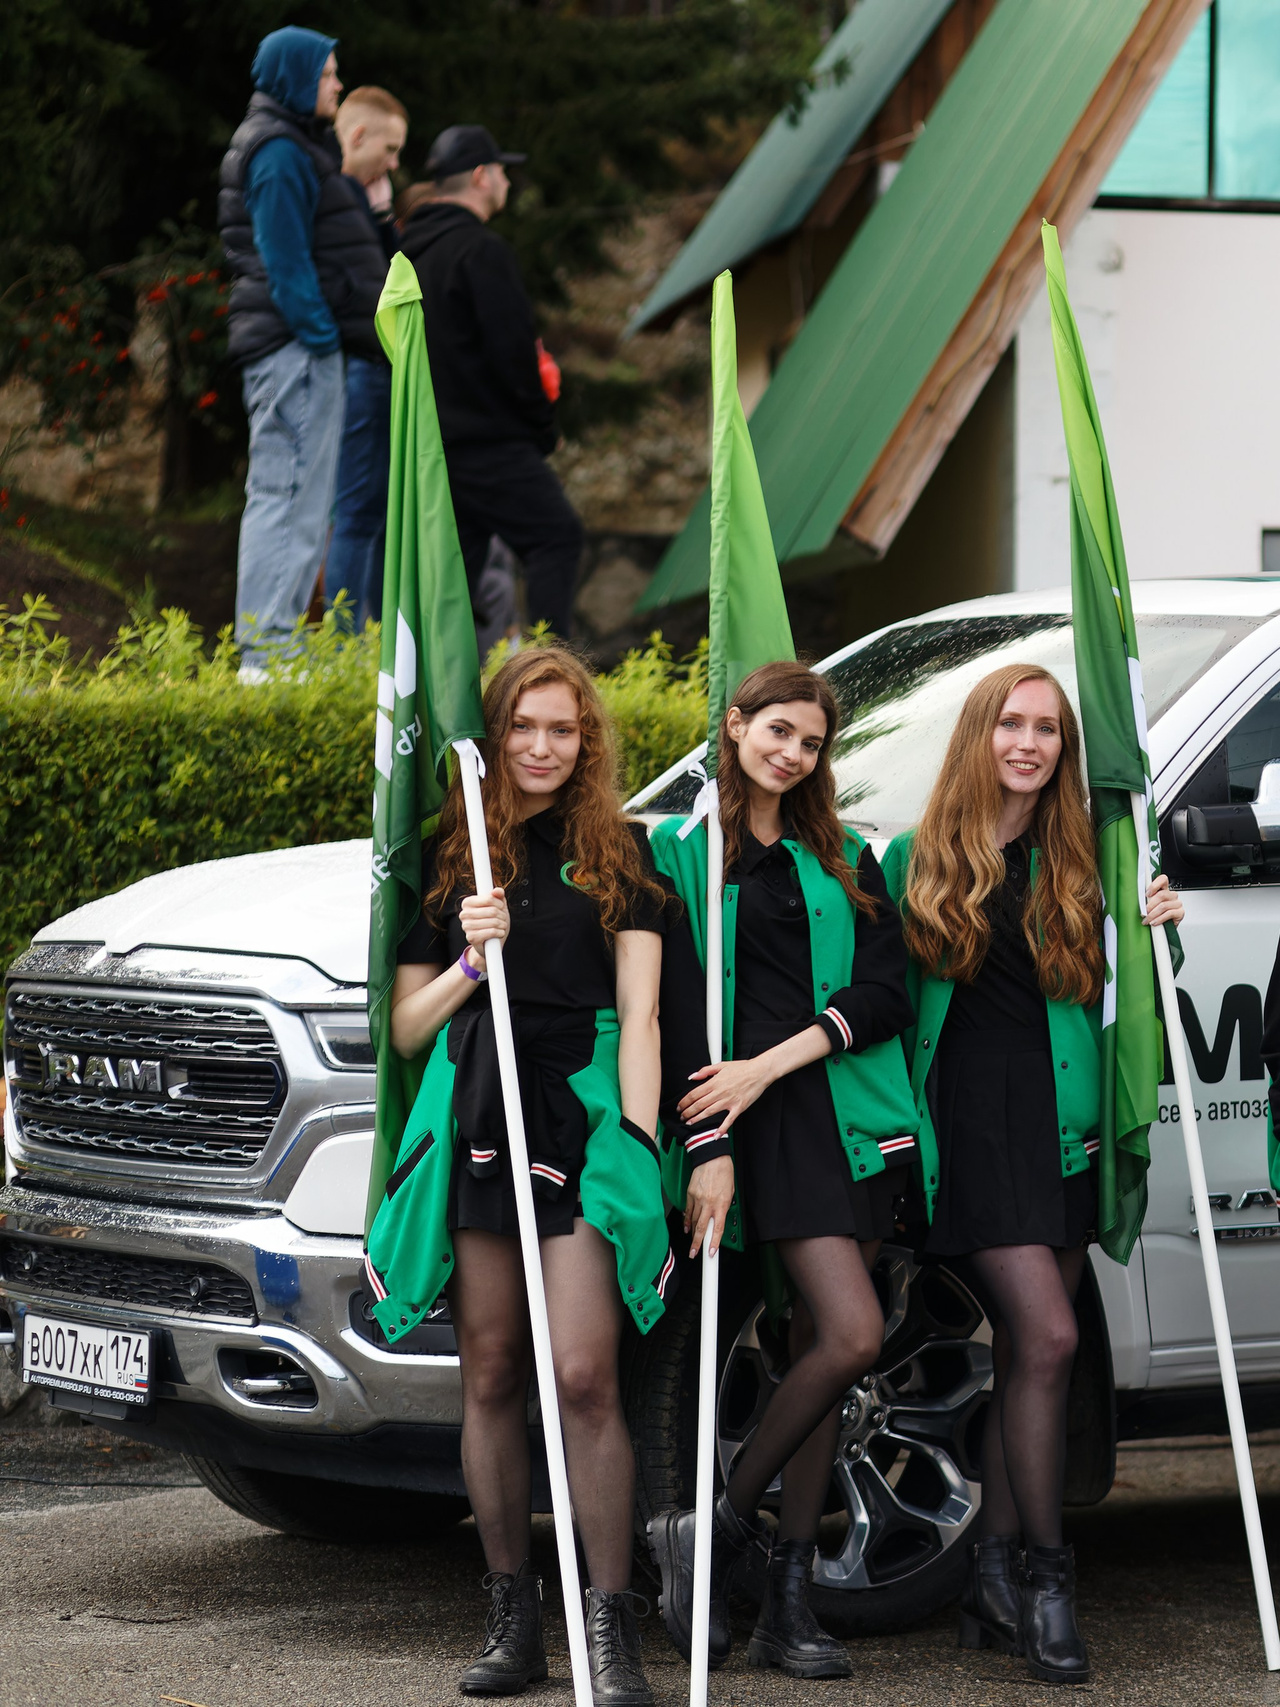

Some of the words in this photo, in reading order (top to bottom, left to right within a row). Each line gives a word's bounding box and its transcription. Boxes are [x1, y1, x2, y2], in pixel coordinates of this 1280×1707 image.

[48, 1051, 162, 1093] RAM
[1158, 1101, 1202, 1124] сеь
[111, 1335, 144, 1373] 174
[117, 1372, 134, 1386] RUS
